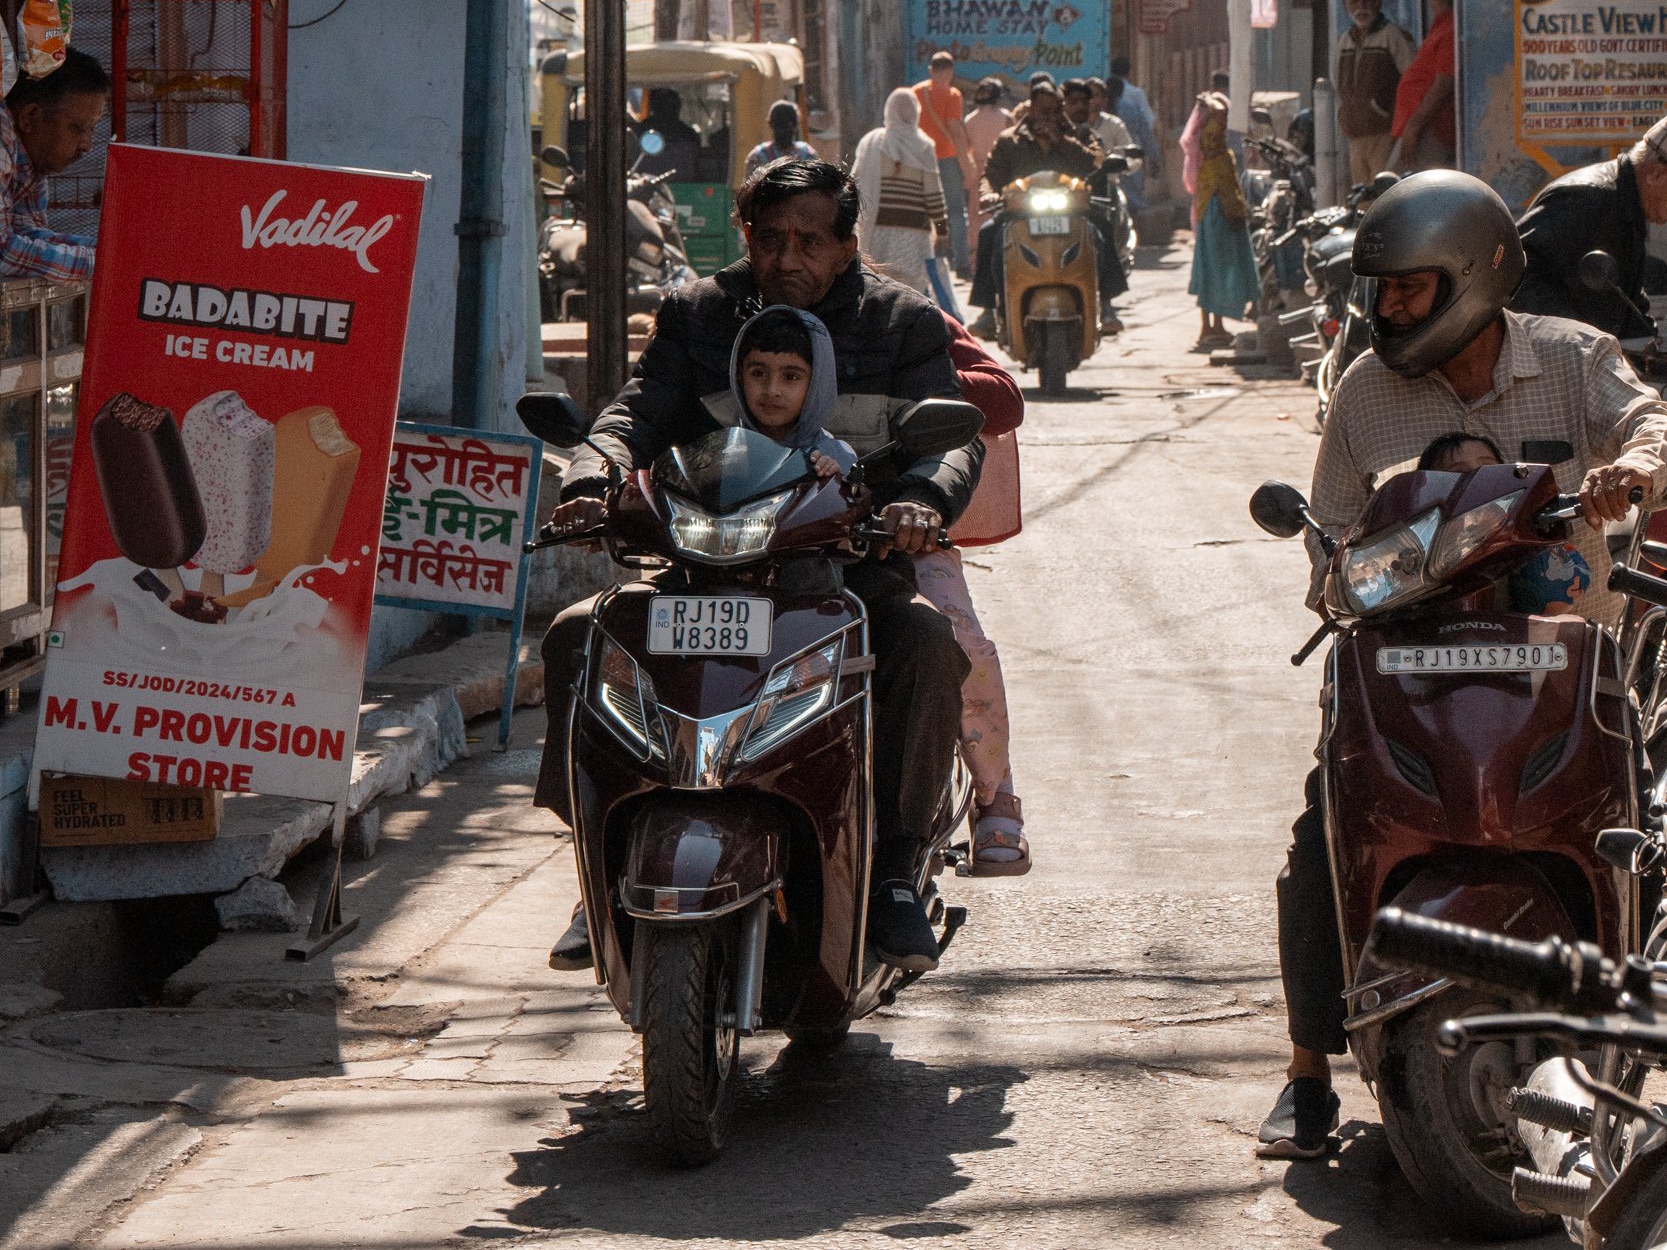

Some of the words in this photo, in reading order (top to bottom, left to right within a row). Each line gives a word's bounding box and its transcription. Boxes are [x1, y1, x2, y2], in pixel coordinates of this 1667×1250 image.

[926, 19, 989, 36] HOME
[999, 17, 1049, 37] STAY
[240, 189, 395, 273] Vadilal
[142, 280, 351, 340] BADABITE
[165, 334, 208, 360] ICE
[215, 341, 315, 372] CREAM
[673, 600, 750, 624] RJ19D
[673, 626, 749, 650] W8389
[1439, 621, 1507, 634] HONDA
[1415, 646, 1554, 667] RJ19XS7901
[281, 692, 296, 707] A
[44, 696, 122, 734] M.V.
[133, 706, 346, 761] PROVISION
[127, 752, 253, 793] STORE
[53, 790, 85, 803] FEEL
[54, 802, 98, 816] SUPER
[54, 814, 126, 829] HYDRATED
